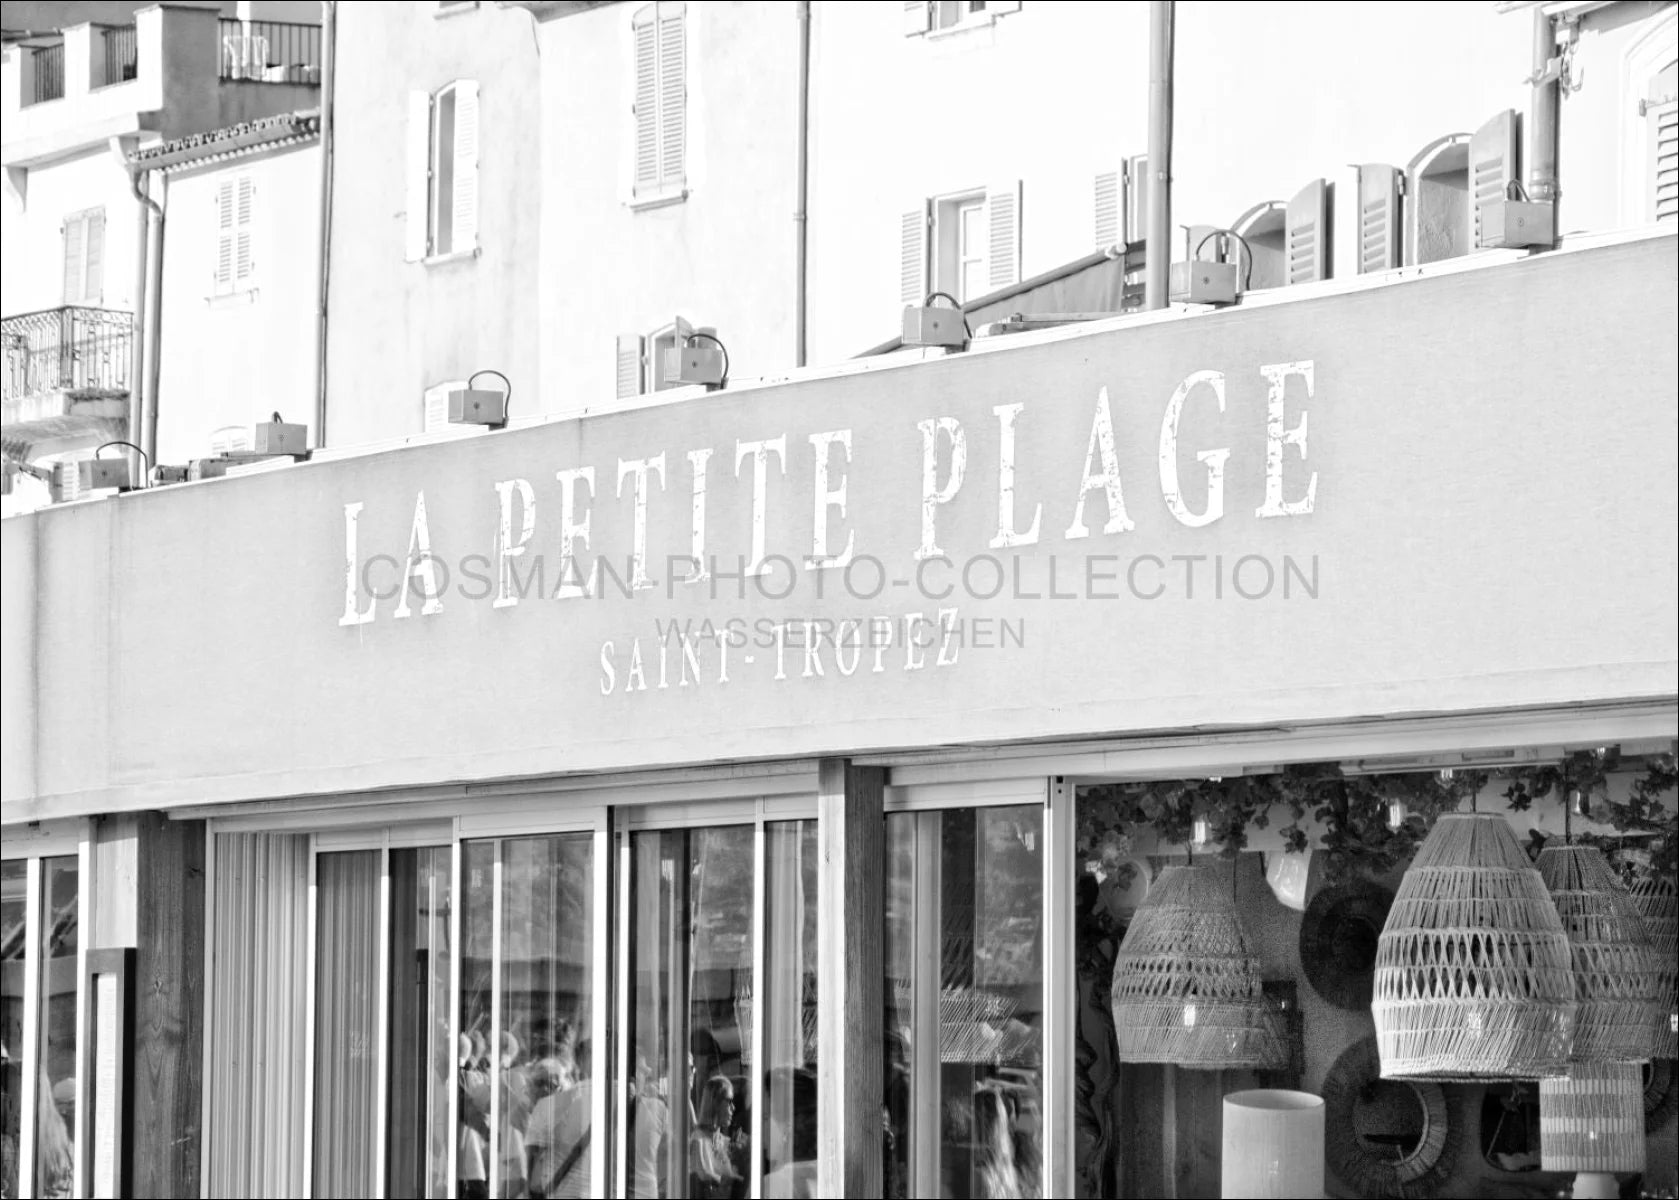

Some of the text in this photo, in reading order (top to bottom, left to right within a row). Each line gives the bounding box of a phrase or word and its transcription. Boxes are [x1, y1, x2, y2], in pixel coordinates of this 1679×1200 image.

[339, 360, 1318, 626] LA PETITE PLAGE
